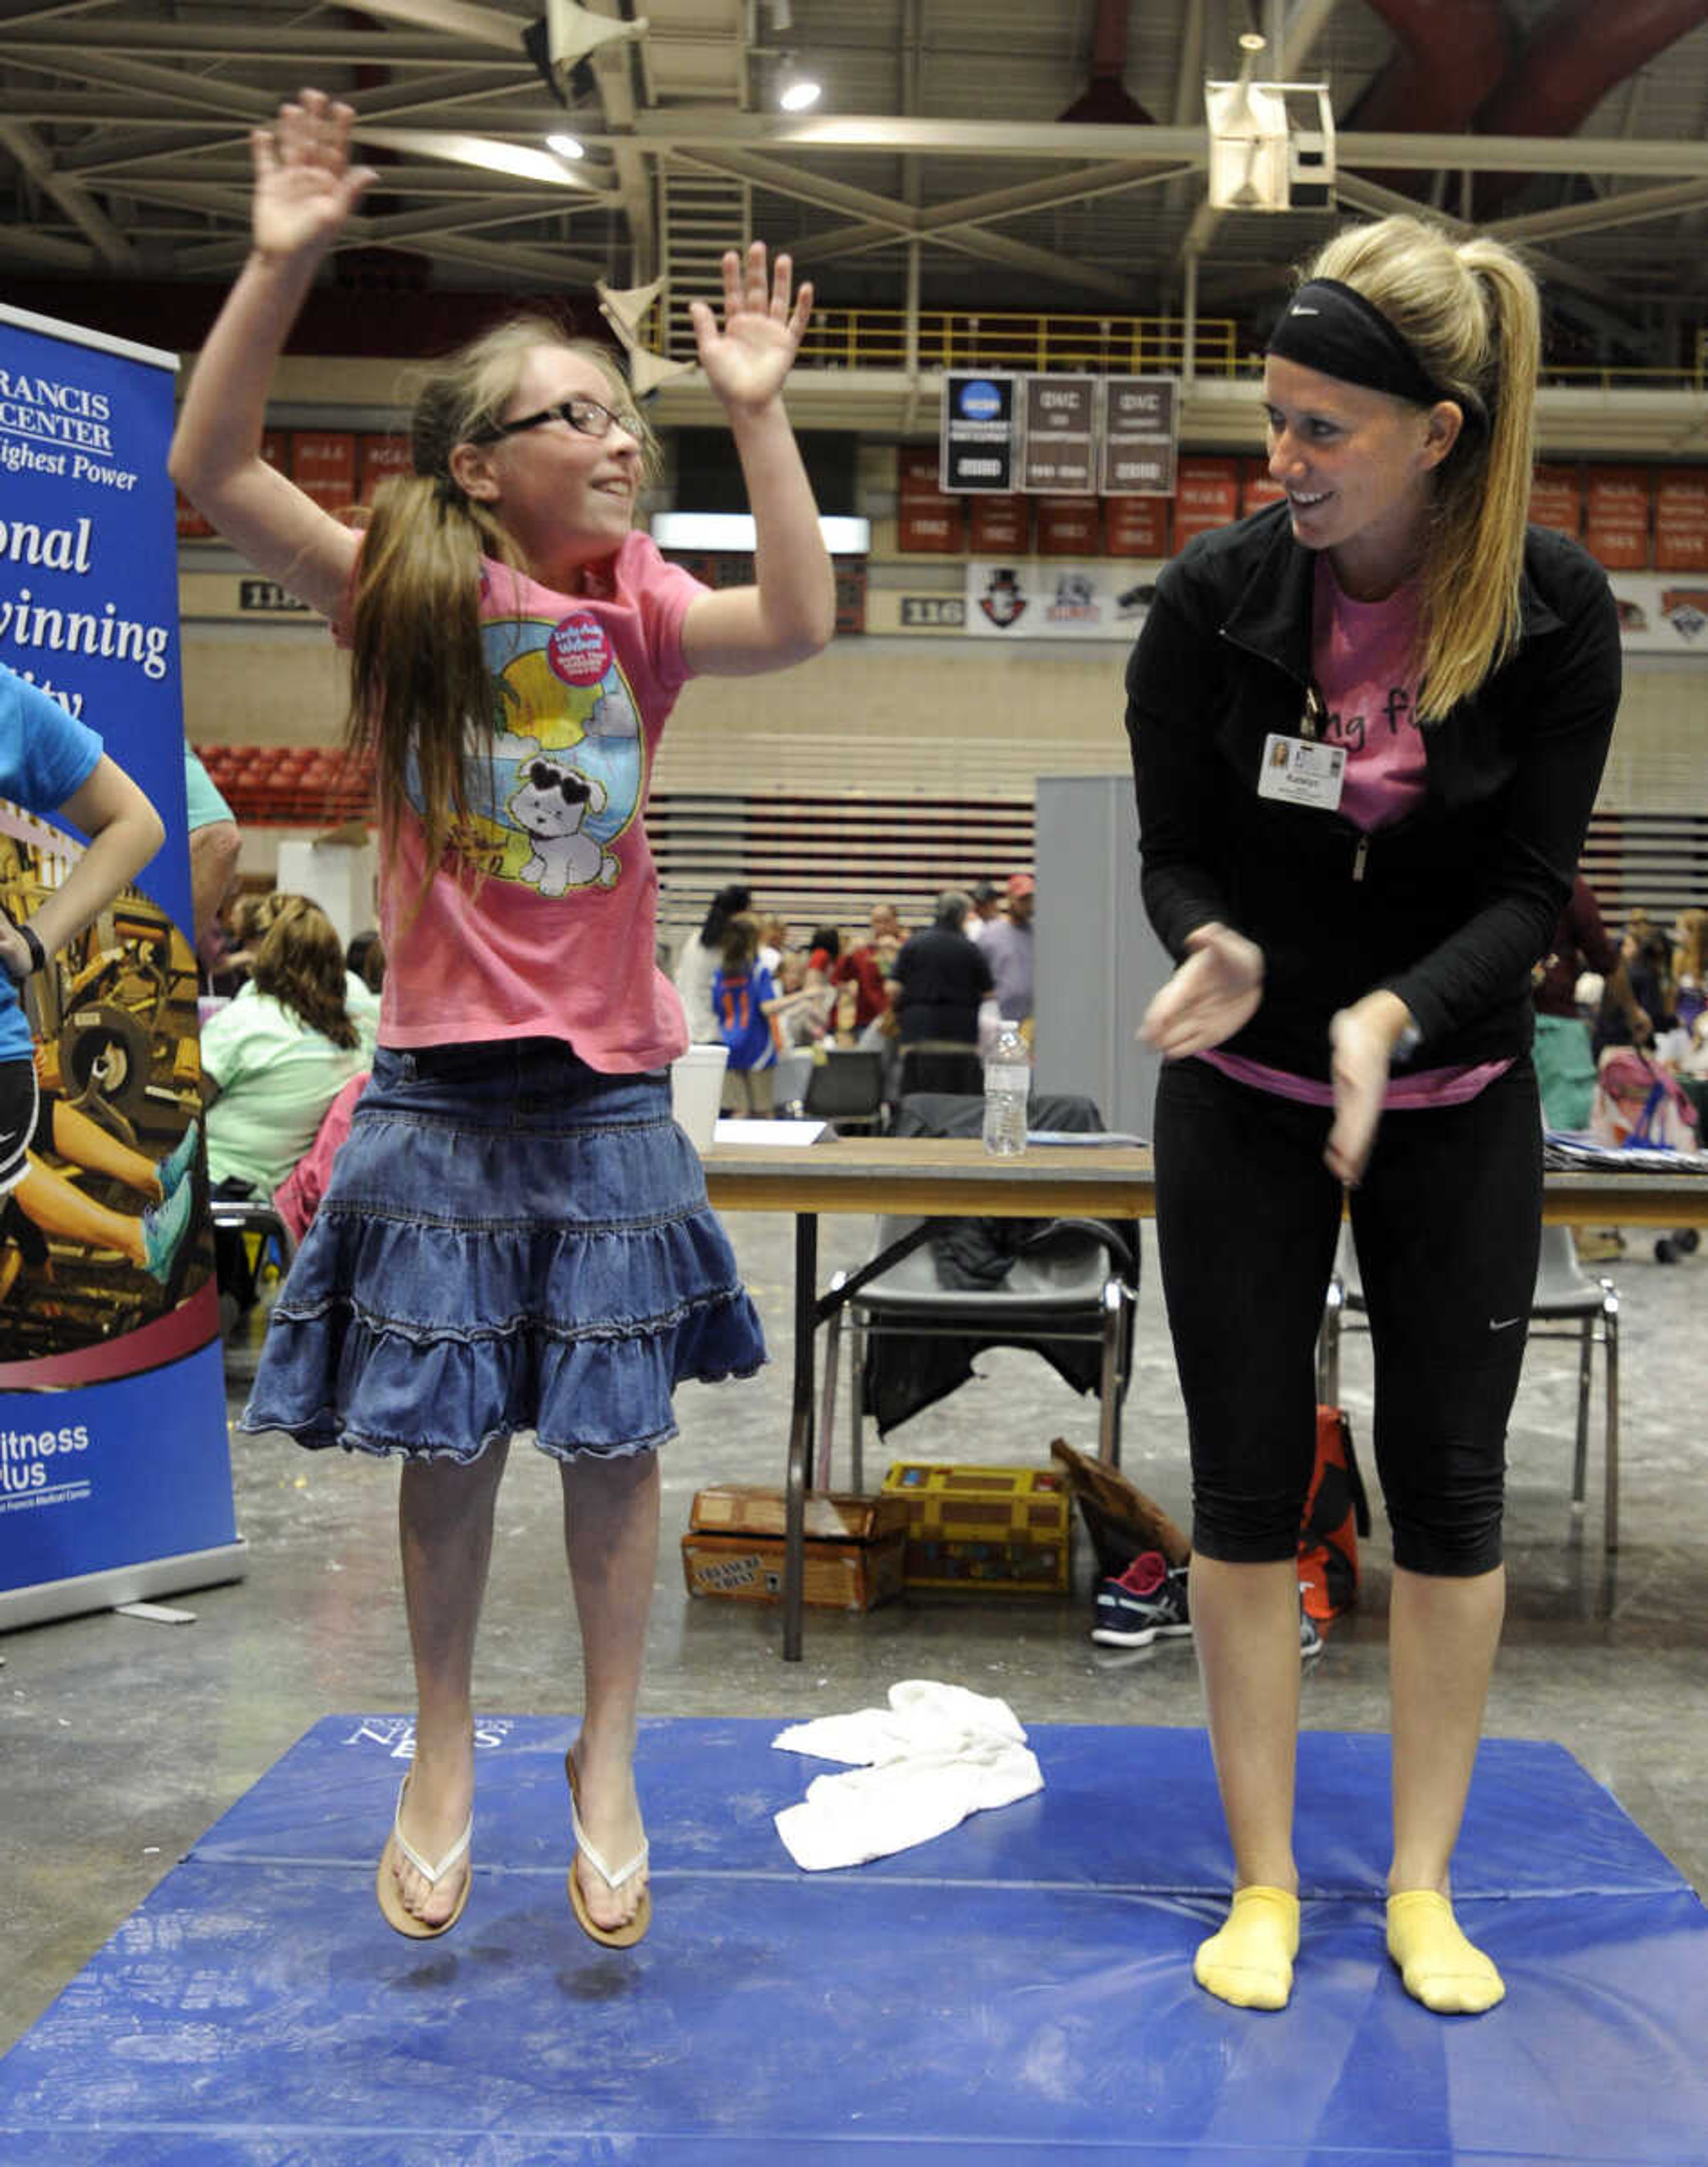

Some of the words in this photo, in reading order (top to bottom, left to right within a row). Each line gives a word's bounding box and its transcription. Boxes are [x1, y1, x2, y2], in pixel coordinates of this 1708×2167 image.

[0, 402, 111, 449] CENTER
[0, 438, 66, 475] ighest
[72, 455, 137, 491] Power
[250, 585, 305, 608] 11
[0, 1461, 46, 1491] lus
